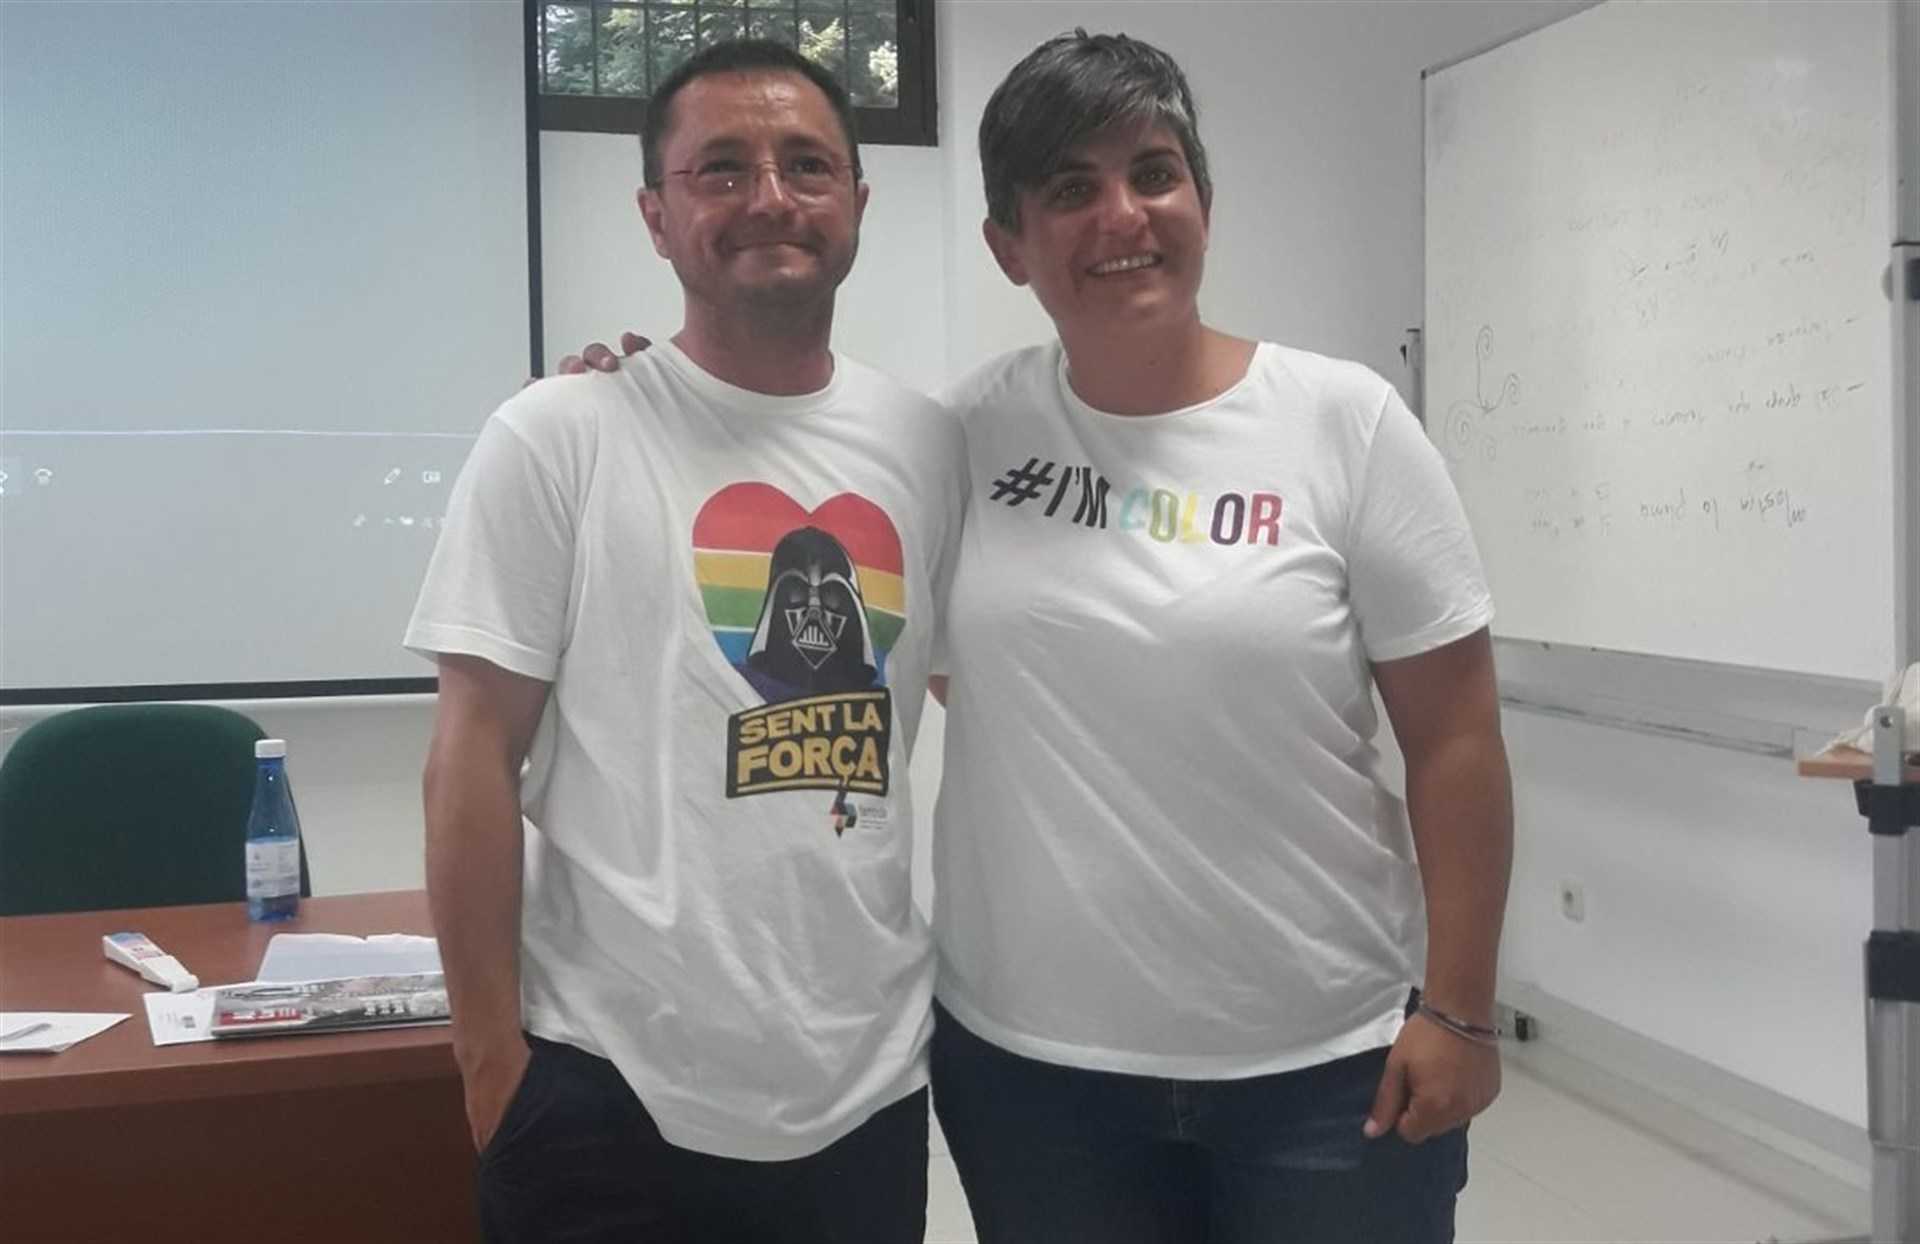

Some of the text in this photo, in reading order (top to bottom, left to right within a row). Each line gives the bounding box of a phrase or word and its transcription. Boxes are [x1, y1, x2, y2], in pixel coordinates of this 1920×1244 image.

[990, 458, 1282, 546] #I'M COLOR
[739, 702, 883, 744] SENT LA
[737, 736, 883, 786] FORÇA
